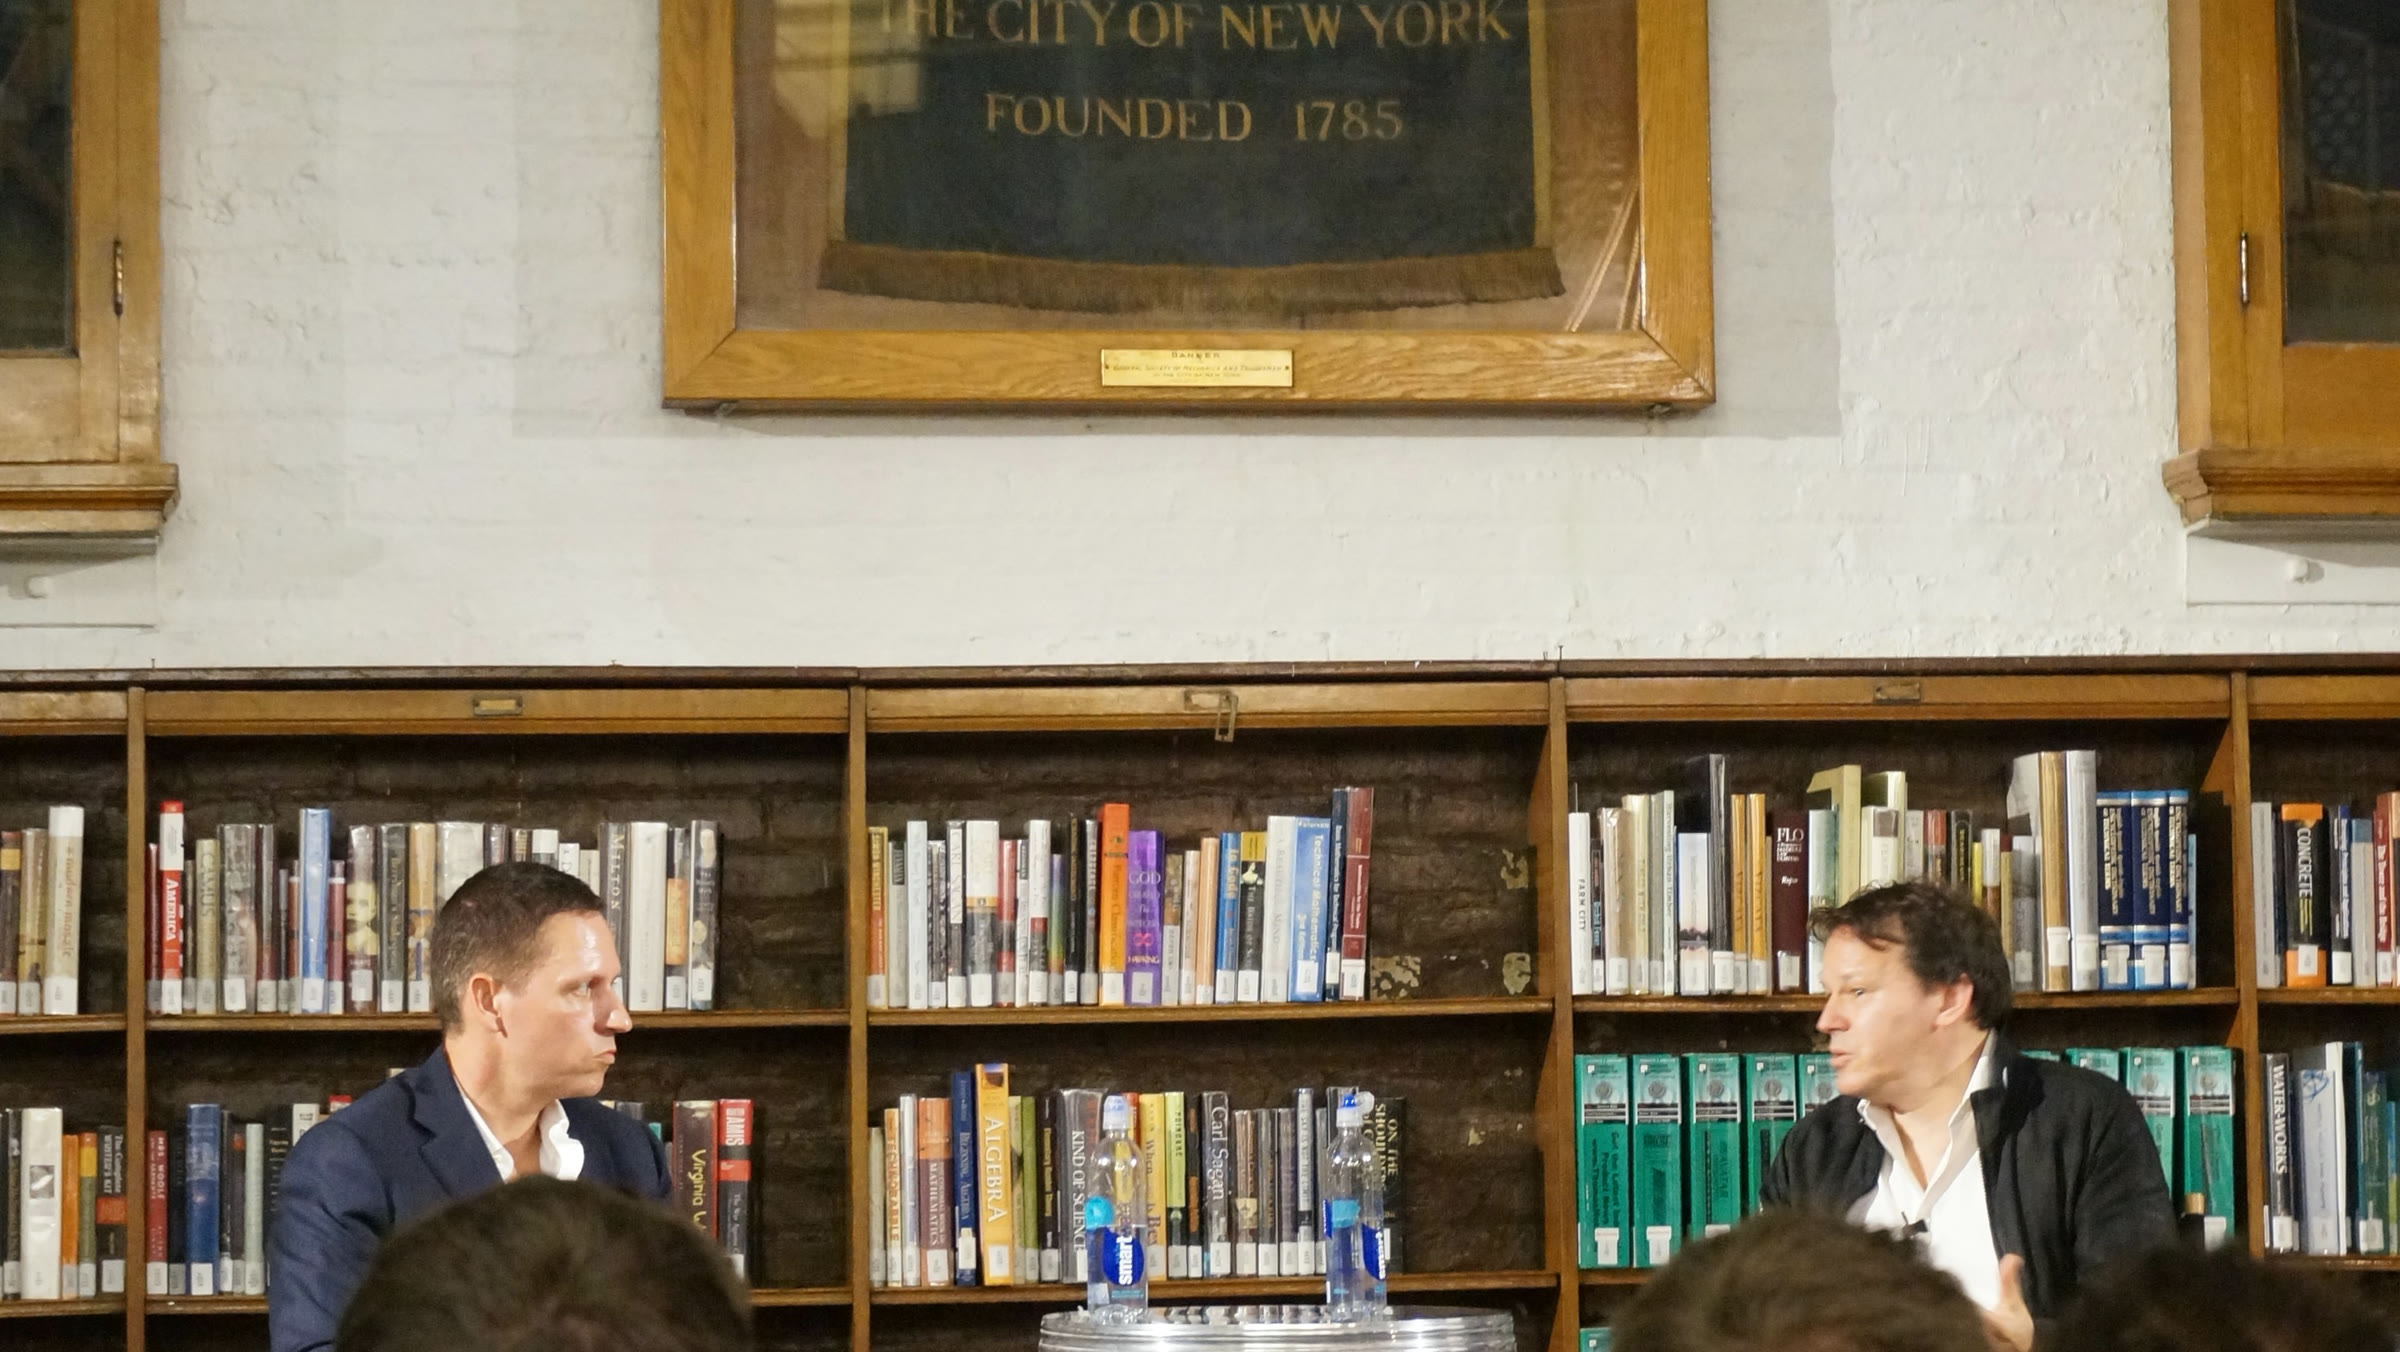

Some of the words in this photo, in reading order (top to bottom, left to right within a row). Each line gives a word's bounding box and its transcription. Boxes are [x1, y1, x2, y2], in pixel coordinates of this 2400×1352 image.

[987, 0, 1118, 45] CITY
[1128, 1, 1204, 48] OF
[1221, 4, 1342, 49] NEW
[1359, 0, 1511, 48] YORK
[986, 93, 1252, 141] FOUNDED
[1295, 100, 1403, 141] 1785
[1776, 827, 1804, 842] FLO
[611, 833, 625, 911] MILTON
[1129, 871, 1161, 884] GOD
[1313, 834, 1324, 887] Technical
[2297, 827, 2313, 897] CONCRETE
[166, 878, 179, 941] AMERICA
[1578, 879, 1586, 906] FARM
[1310, 889, 1321, 960] Mathematics
[1578, 910, 1586, 932] CITY
[114, 1134, 123, 1150] The
[726, 1116, 744, 1146] AMIS
[1211, 1106, 1227, 1141] Carl
[1387, 1118, 1399, 1142] ON
[2273, 1064, 2288, 1175] WATER-WORKS
[984, 1115, 1008, 1223] ALGEBRA
[1072, 1130, 1085, 1166] KIND
[1145, 1140, 1155, 1175] When
[1387, 1148, 1399, 1177] THE
[688, 1148, 707, 1205] Virginia
[886, 1139, 899, 1241] TECHNOBABBLE
[1072, 1170, 1085, 1190] OF
[1207, 1148, 1229, 1201] Sagan
[929, 1161, 940, 1246] MATHEMATICS
[960, 1180, 972, 1220] ALGEBRA
[1073, 1193, 1086, 1253] SCIENCE
[1147, 1216, 1161, 1247] Bes
[1116, 1235, 1132, 1285] smart
